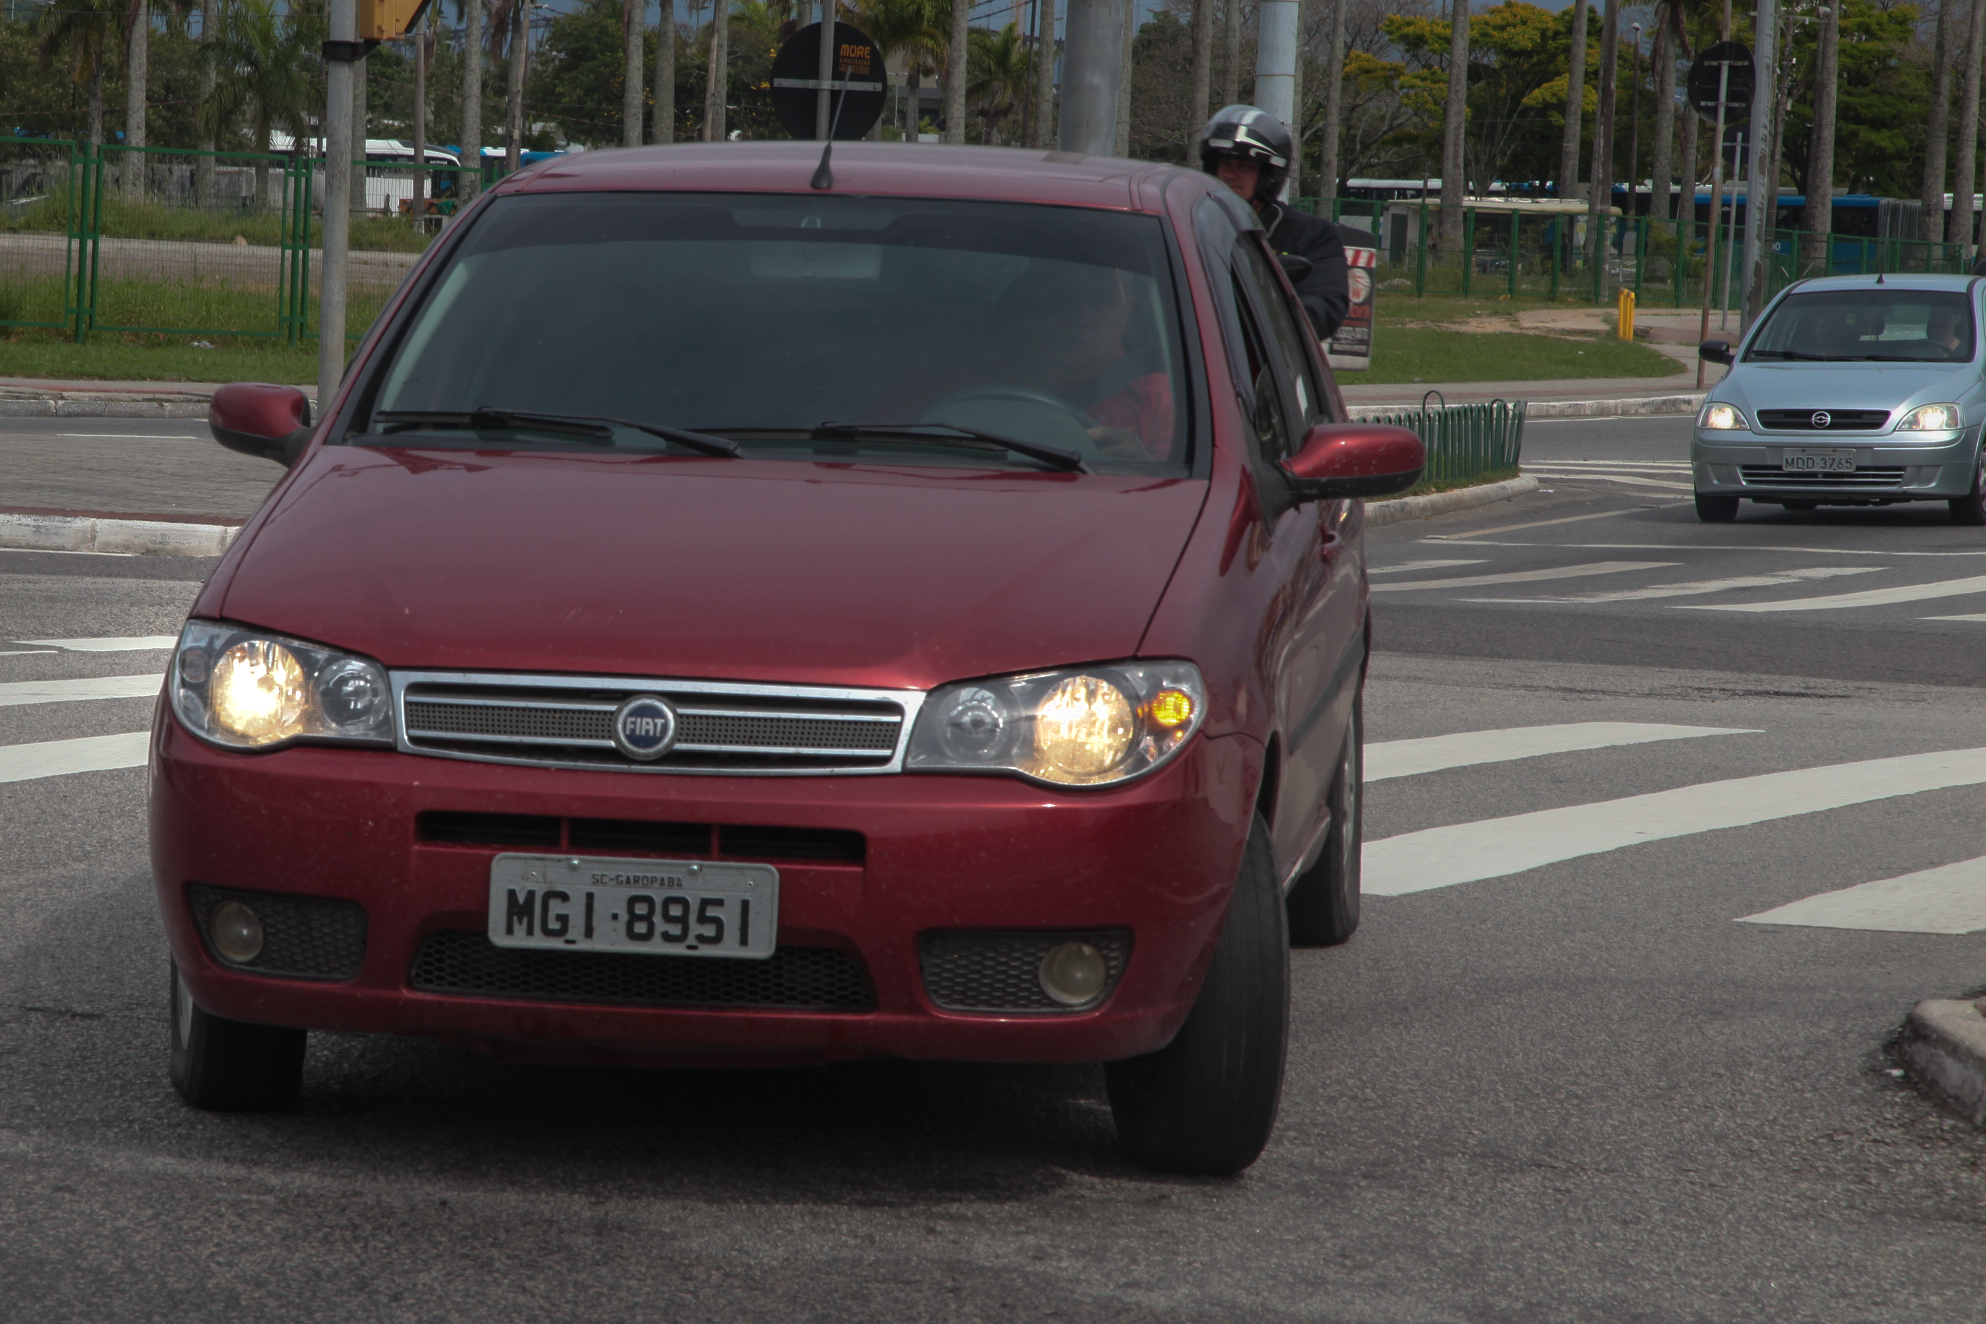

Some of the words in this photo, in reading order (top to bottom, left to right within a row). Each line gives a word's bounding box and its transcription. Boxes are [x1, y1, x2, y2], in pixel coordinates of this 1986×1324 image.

[840, 44, 871, 59] MORE
[625, 717, 666, 737] FIAT
[591, 873, 683, 888] SC-GAROPABA
